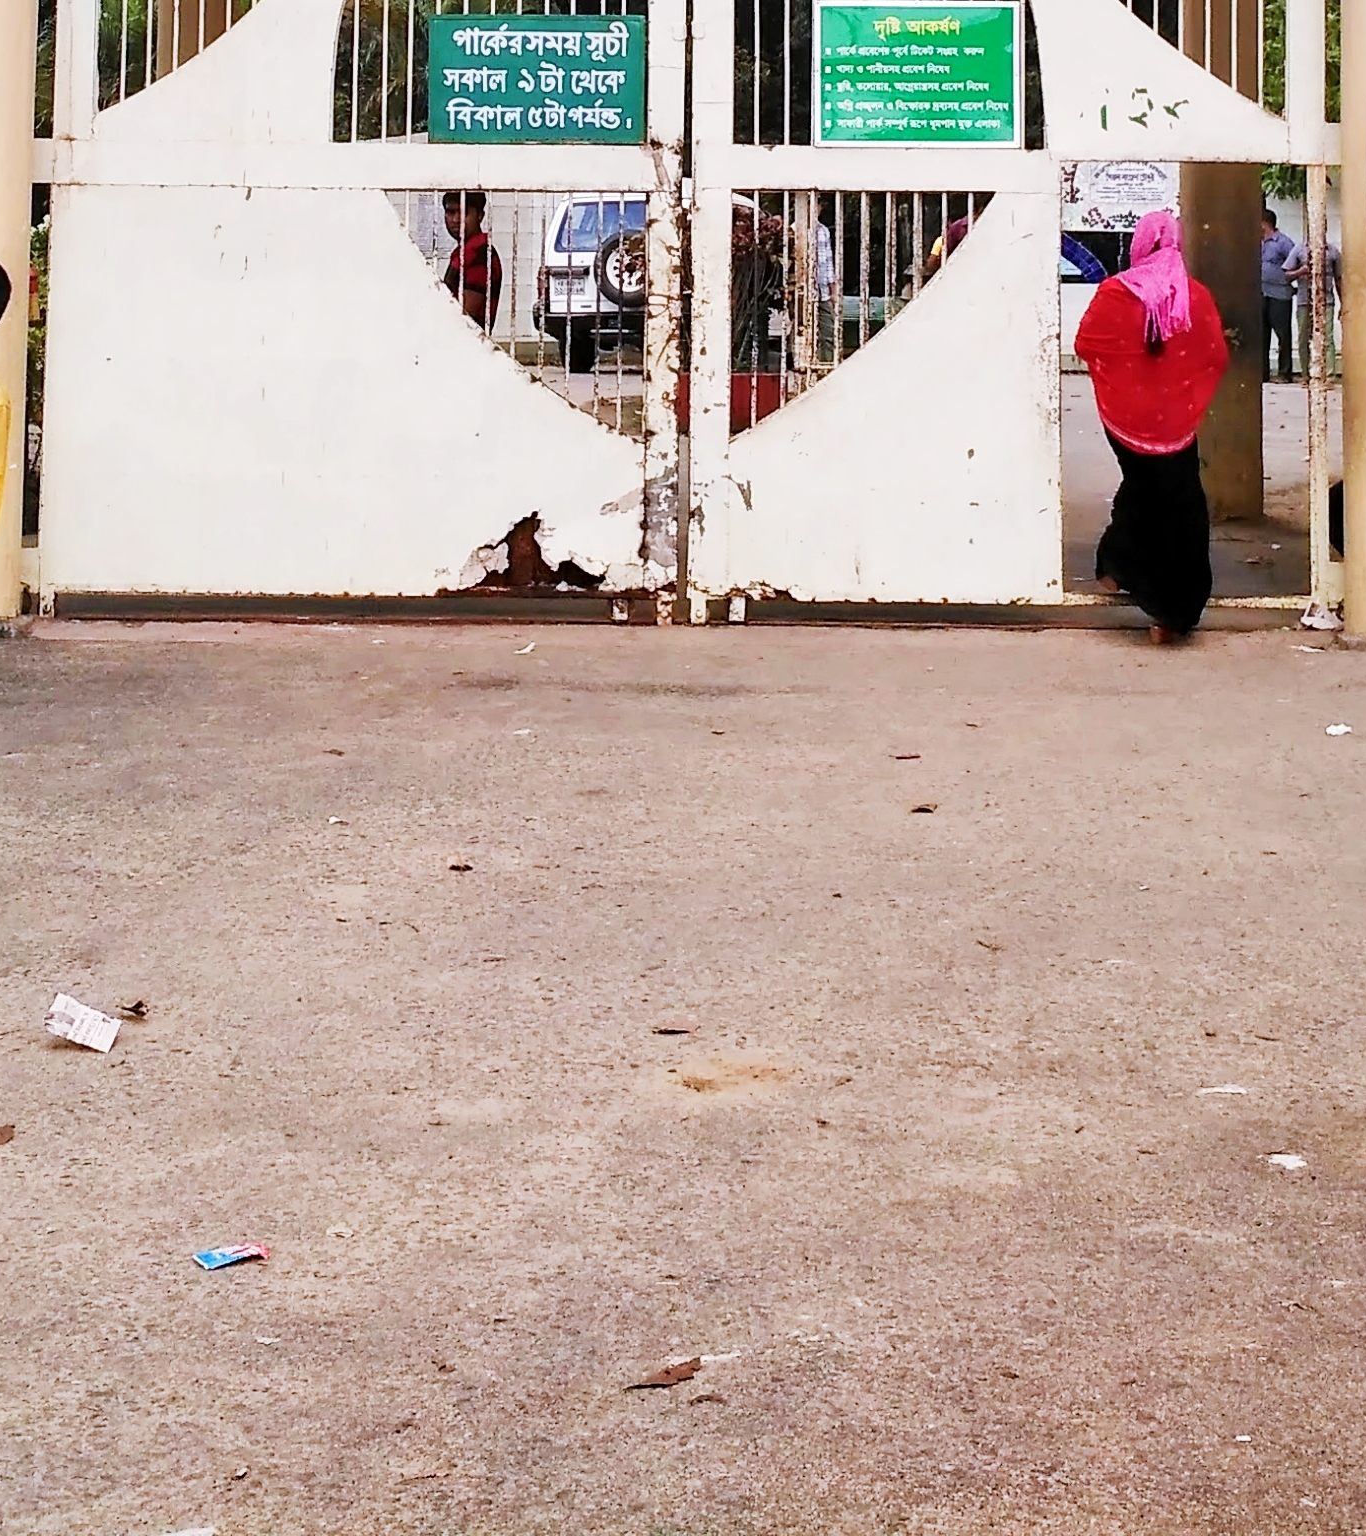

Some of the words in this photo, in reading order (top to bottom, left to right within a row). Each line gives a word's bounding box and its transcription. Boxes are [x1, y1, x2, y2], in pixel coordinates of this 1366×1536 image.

[906, 15, 961, 36] আকর্ষণ
[584, 21, 629, 62] সূচী
[443, 67, 507, 93] সকাল
[571, 69, 626, 95] থেকে
[446, 98, 523, 130] বিকাল
